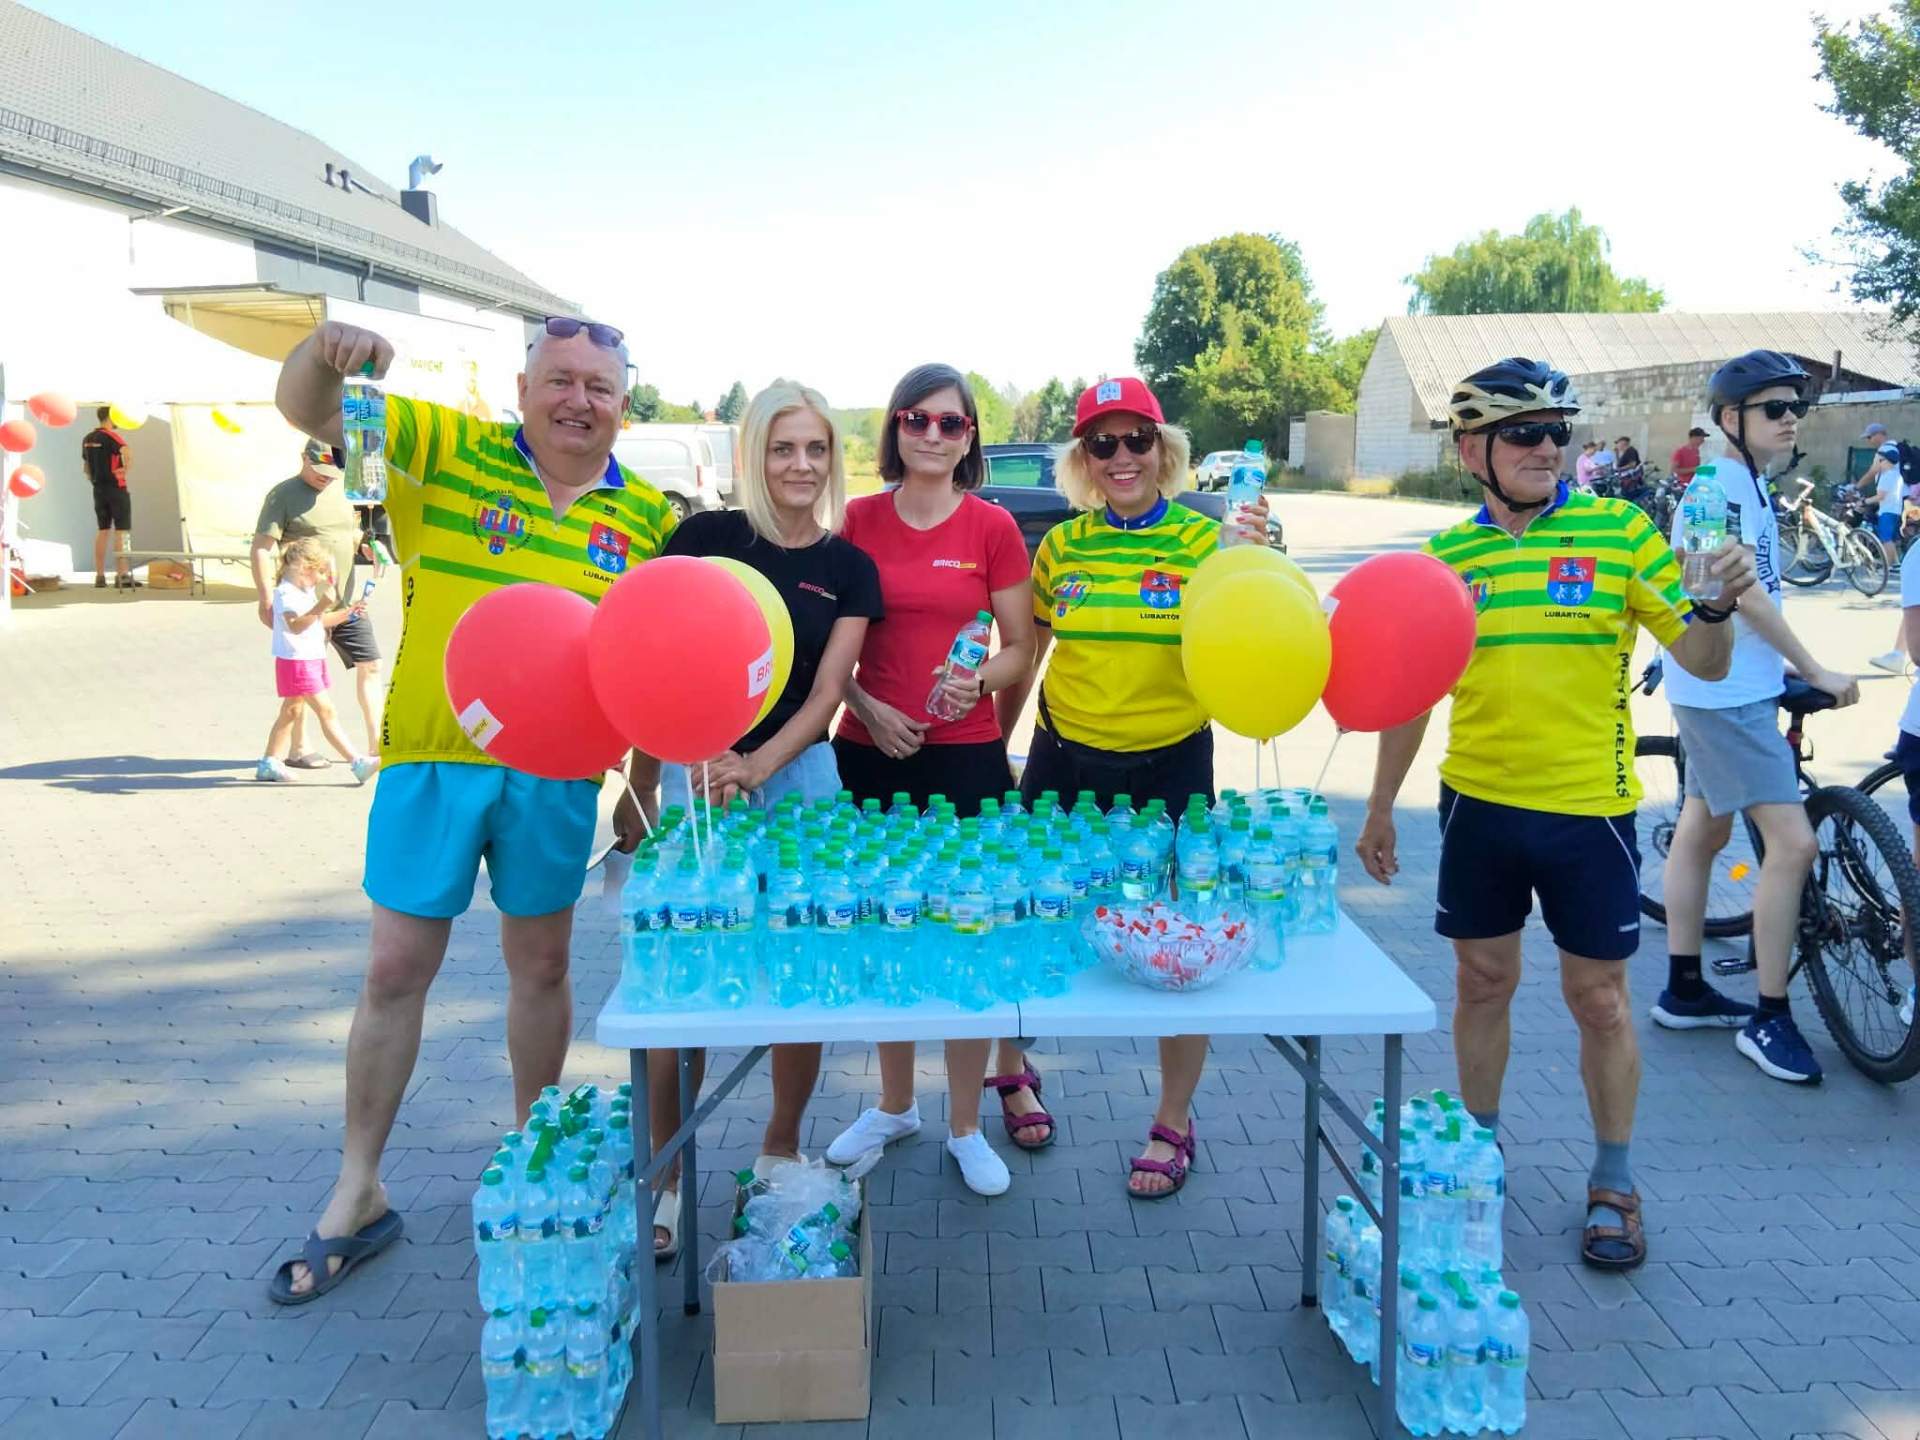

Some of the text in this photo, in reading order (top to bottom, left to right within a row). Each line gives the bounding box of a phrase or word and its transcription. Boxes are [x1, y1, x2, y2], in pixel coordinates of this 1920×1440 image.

[583, 569, 615, 584] LUBART
[1755, 535, 1774, 581] DIVER
[1615, 722, 1630, 799] RELAKS
